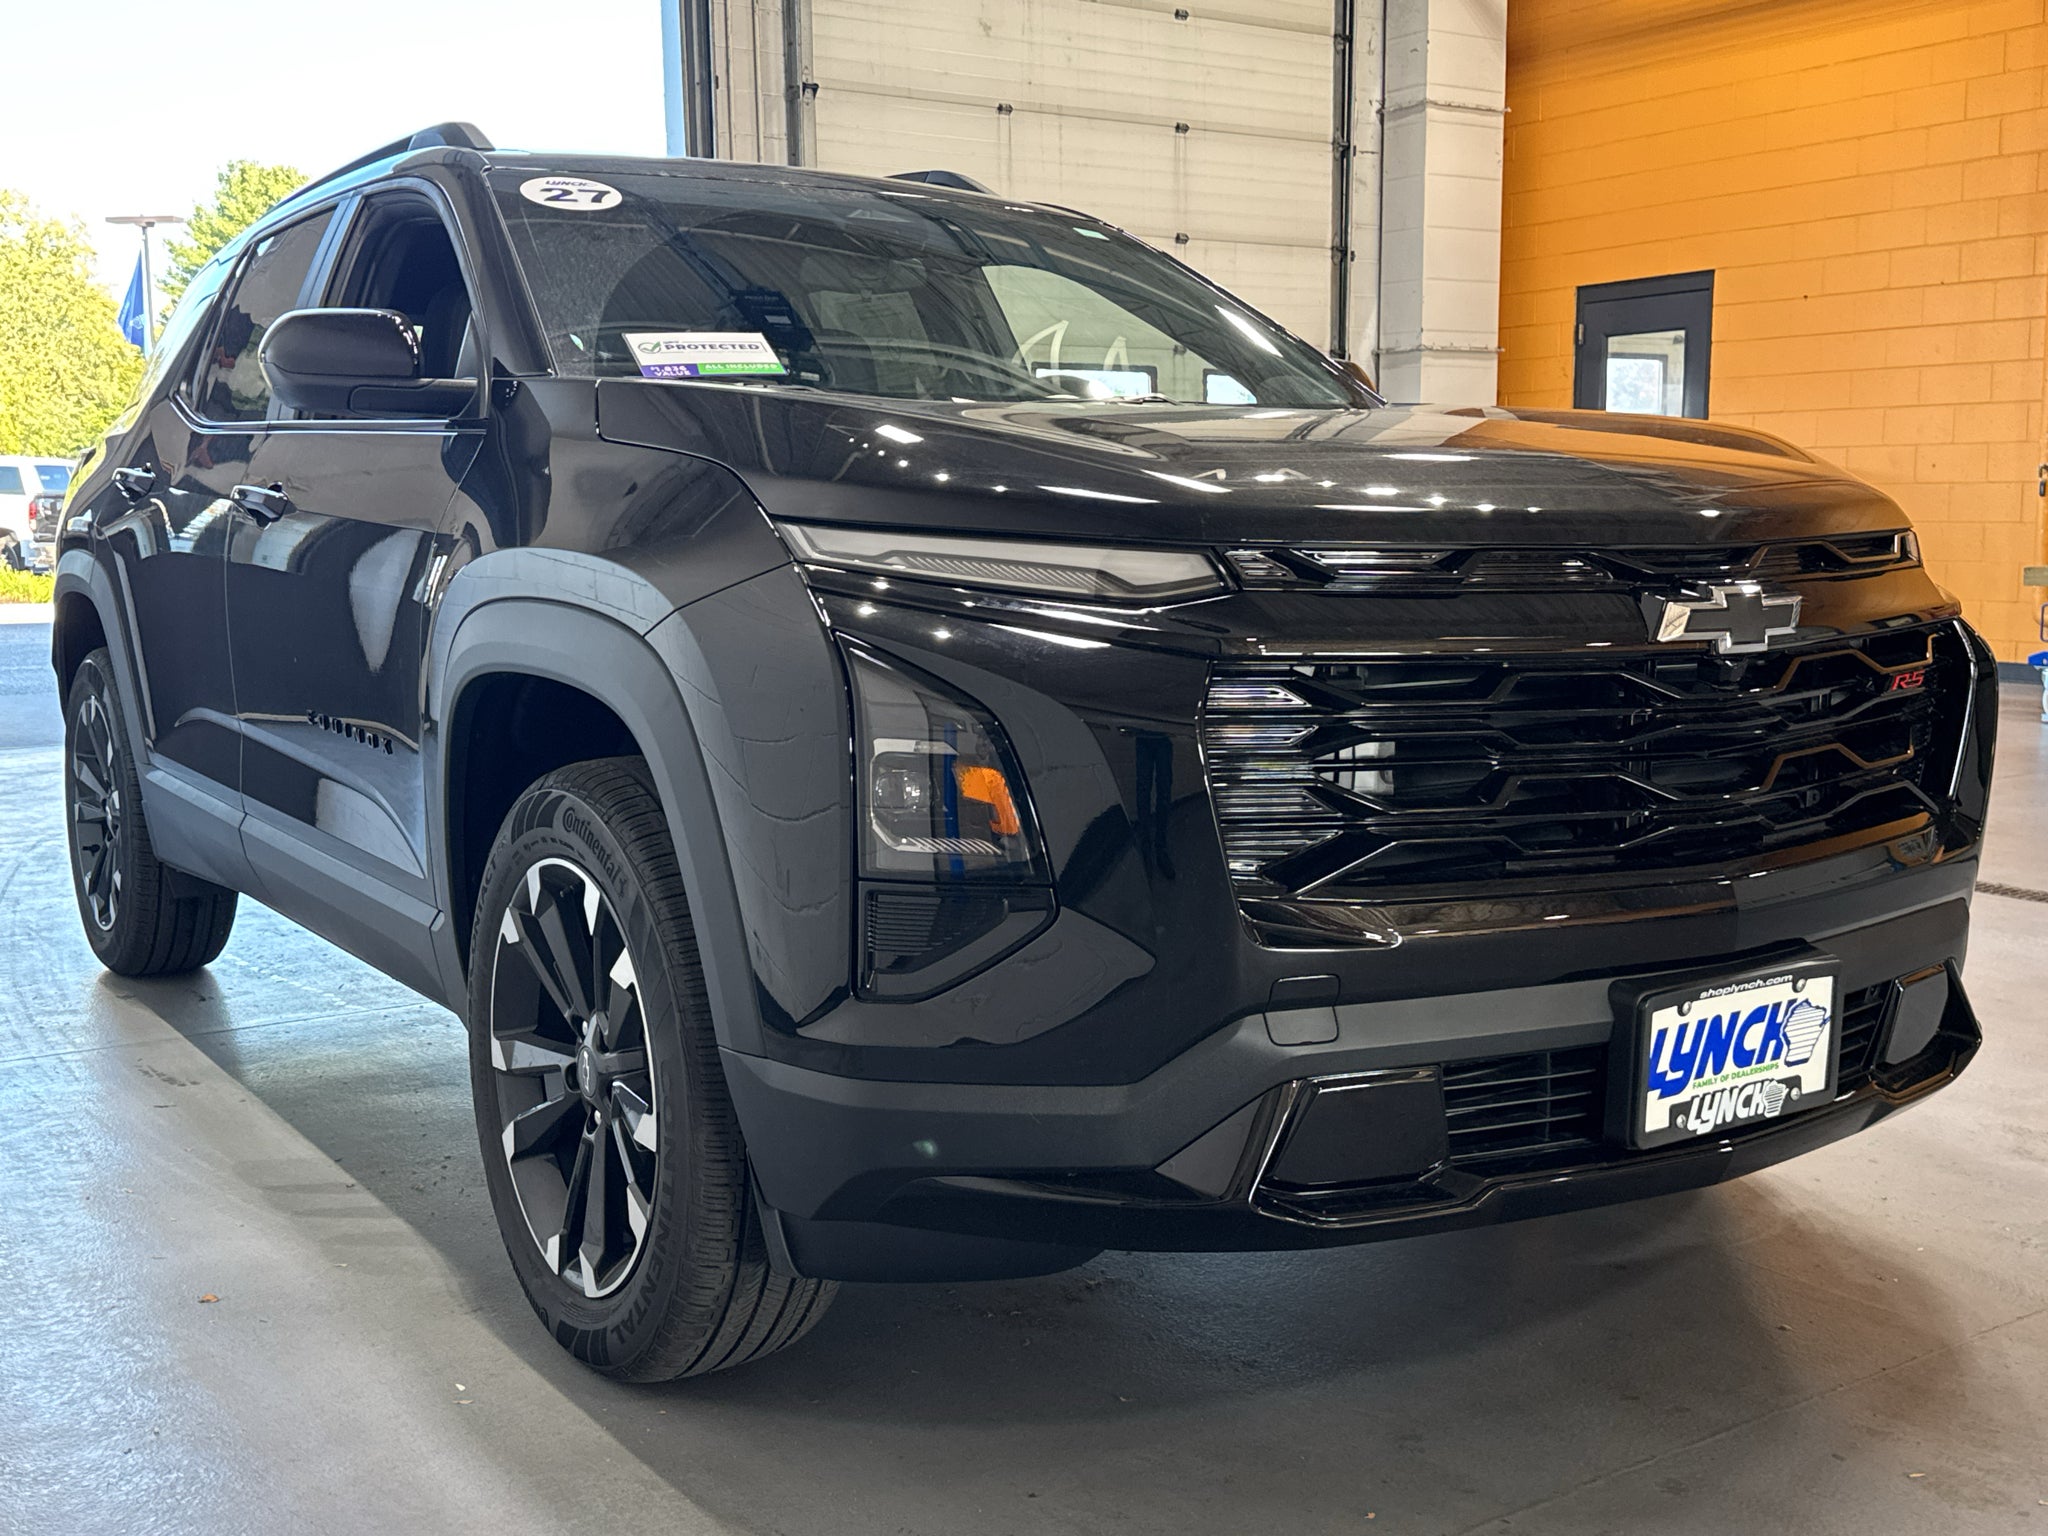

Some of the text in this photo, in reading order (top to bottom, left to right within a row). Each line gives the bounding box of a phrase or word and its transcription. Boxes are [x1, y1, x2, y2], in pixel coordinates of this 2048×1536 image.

[540, 187, 611, 203] 27
[1890, 669, 1926, 692] RS
[562, 806, 623, 885] Continental
[1699, 974, 1794, 1000] shoplynch.com
[1648, 998, 1799, 1100] LYNCH
[1692, 1062, 1780, 1090] FAMILY OF DEALERSHIPS
[1686, 1080, 1772, 1136] LYNCH
